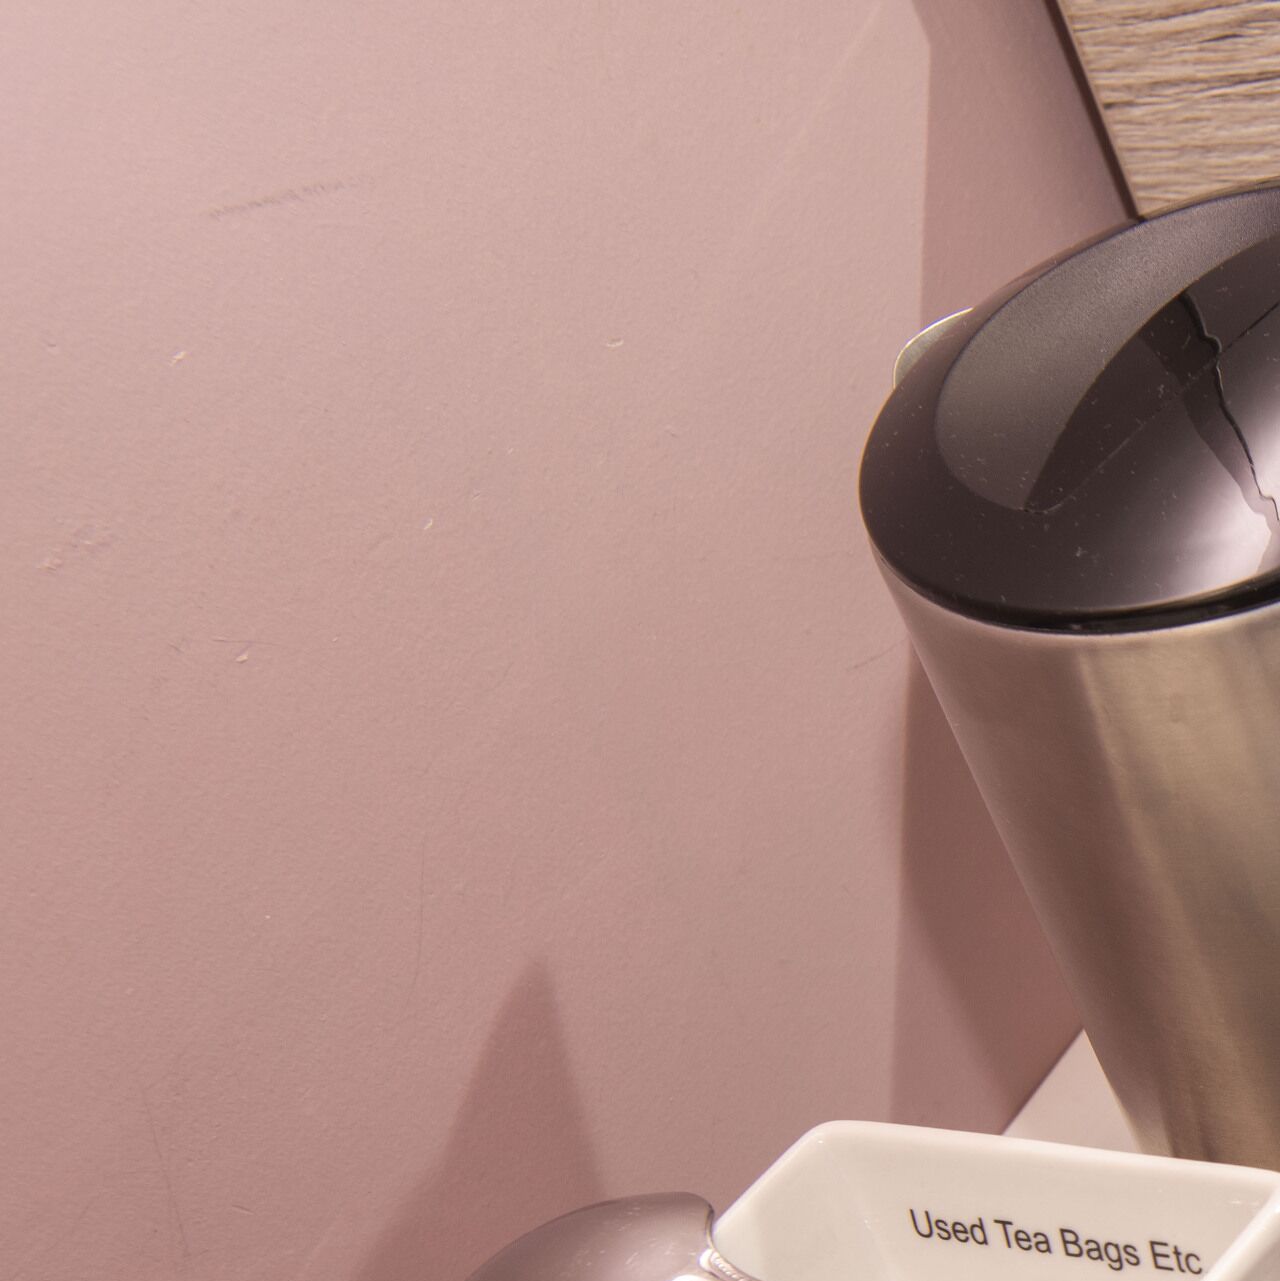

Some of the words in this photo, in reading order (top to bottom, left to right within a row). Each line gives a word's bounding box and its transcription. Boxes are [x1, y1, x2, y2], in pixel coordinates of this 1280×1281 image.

[908, 1208, 989, 1246] Used
[993, 1219, 1053, 1255] Tea
[1059, 1228, 1141, 1272] Bags
[1149, 1240, 1203, 1276] Etc
